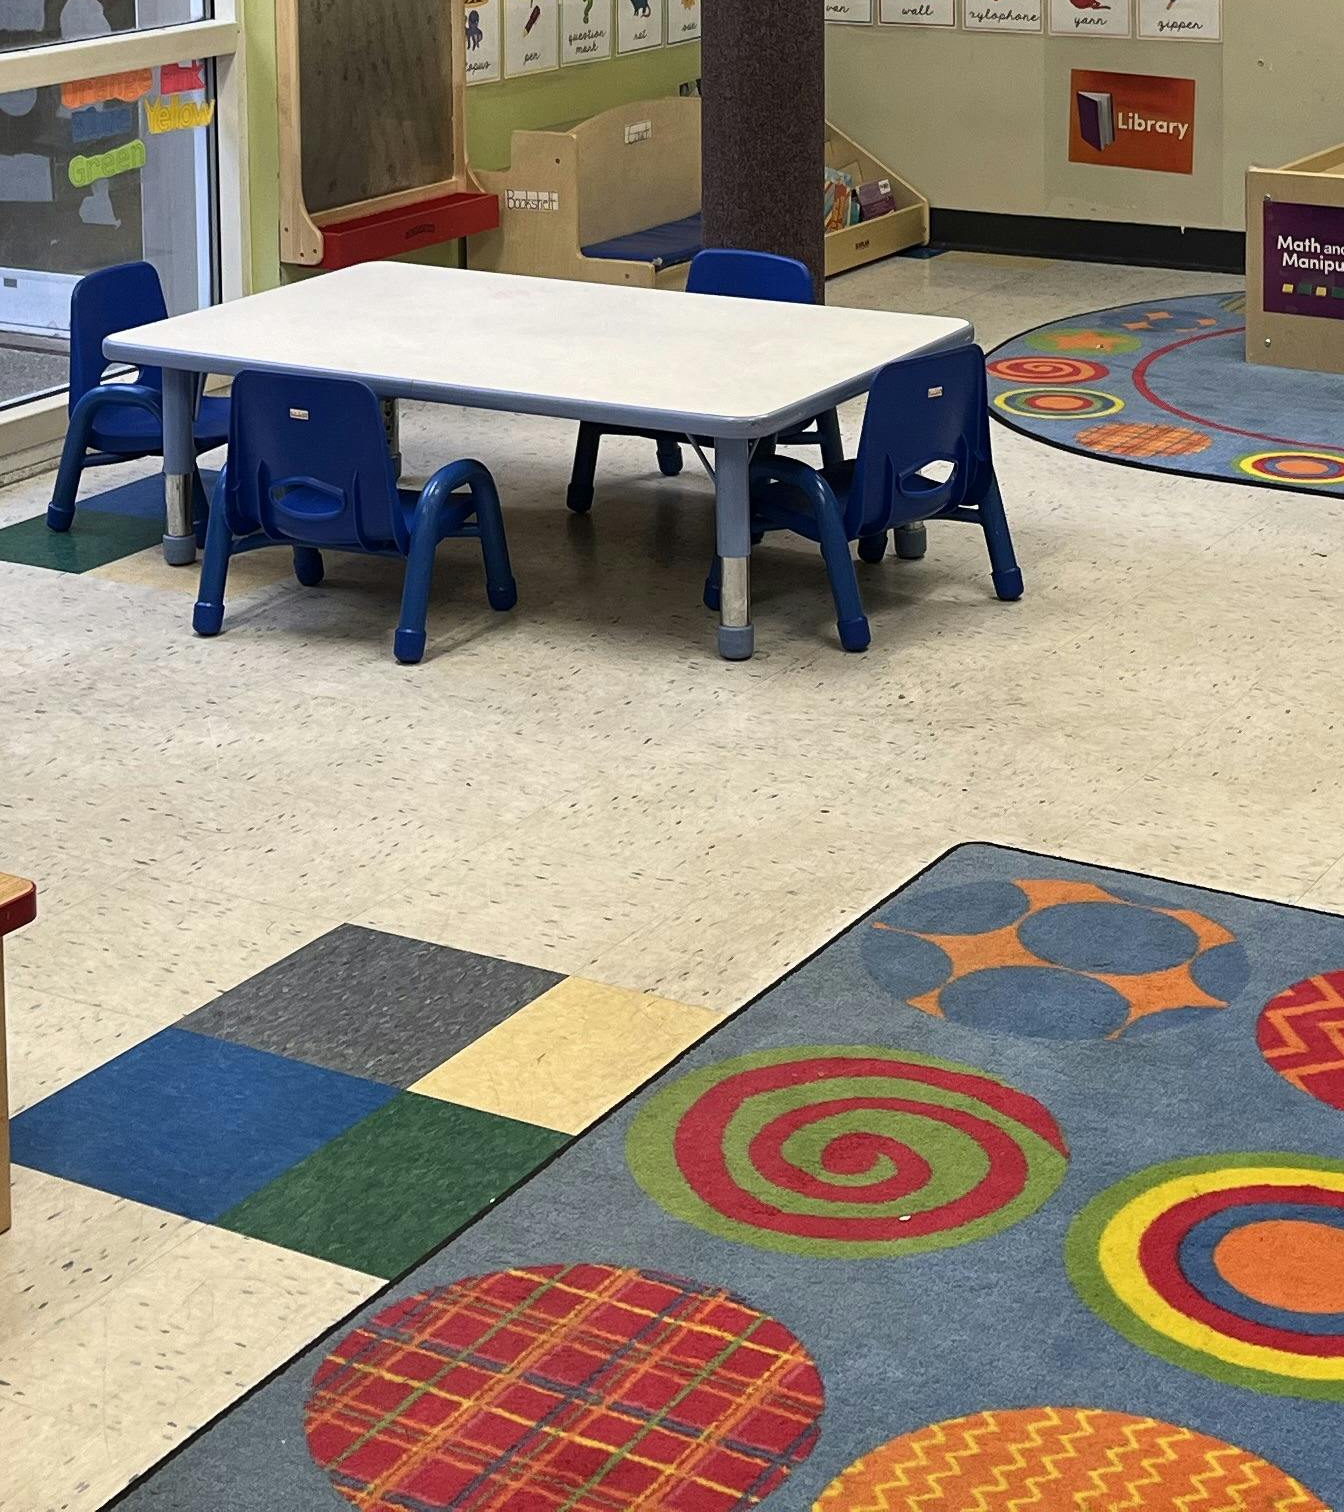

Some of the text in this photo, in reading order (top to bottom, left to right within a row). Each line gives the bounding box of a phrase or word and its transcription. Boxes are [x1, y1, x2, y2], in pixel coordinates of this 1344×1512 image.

[825, 3, 850, 15] van
[902, 3, 934, 18] wall
[969, 7, 1042, 24] xylophone
[1074, 15, 1108, 28] yarn
[1157, 19, 1204, 32] zipper
[569, 28, 608, 46] question
[523, 52, 541, 66] pen
[144, 95, 216, 134] Yellow
[1118, 112, 1189, 141] Library
[72, 142, 146, 185] Green
[1276, 233, 1321, 255] Math
